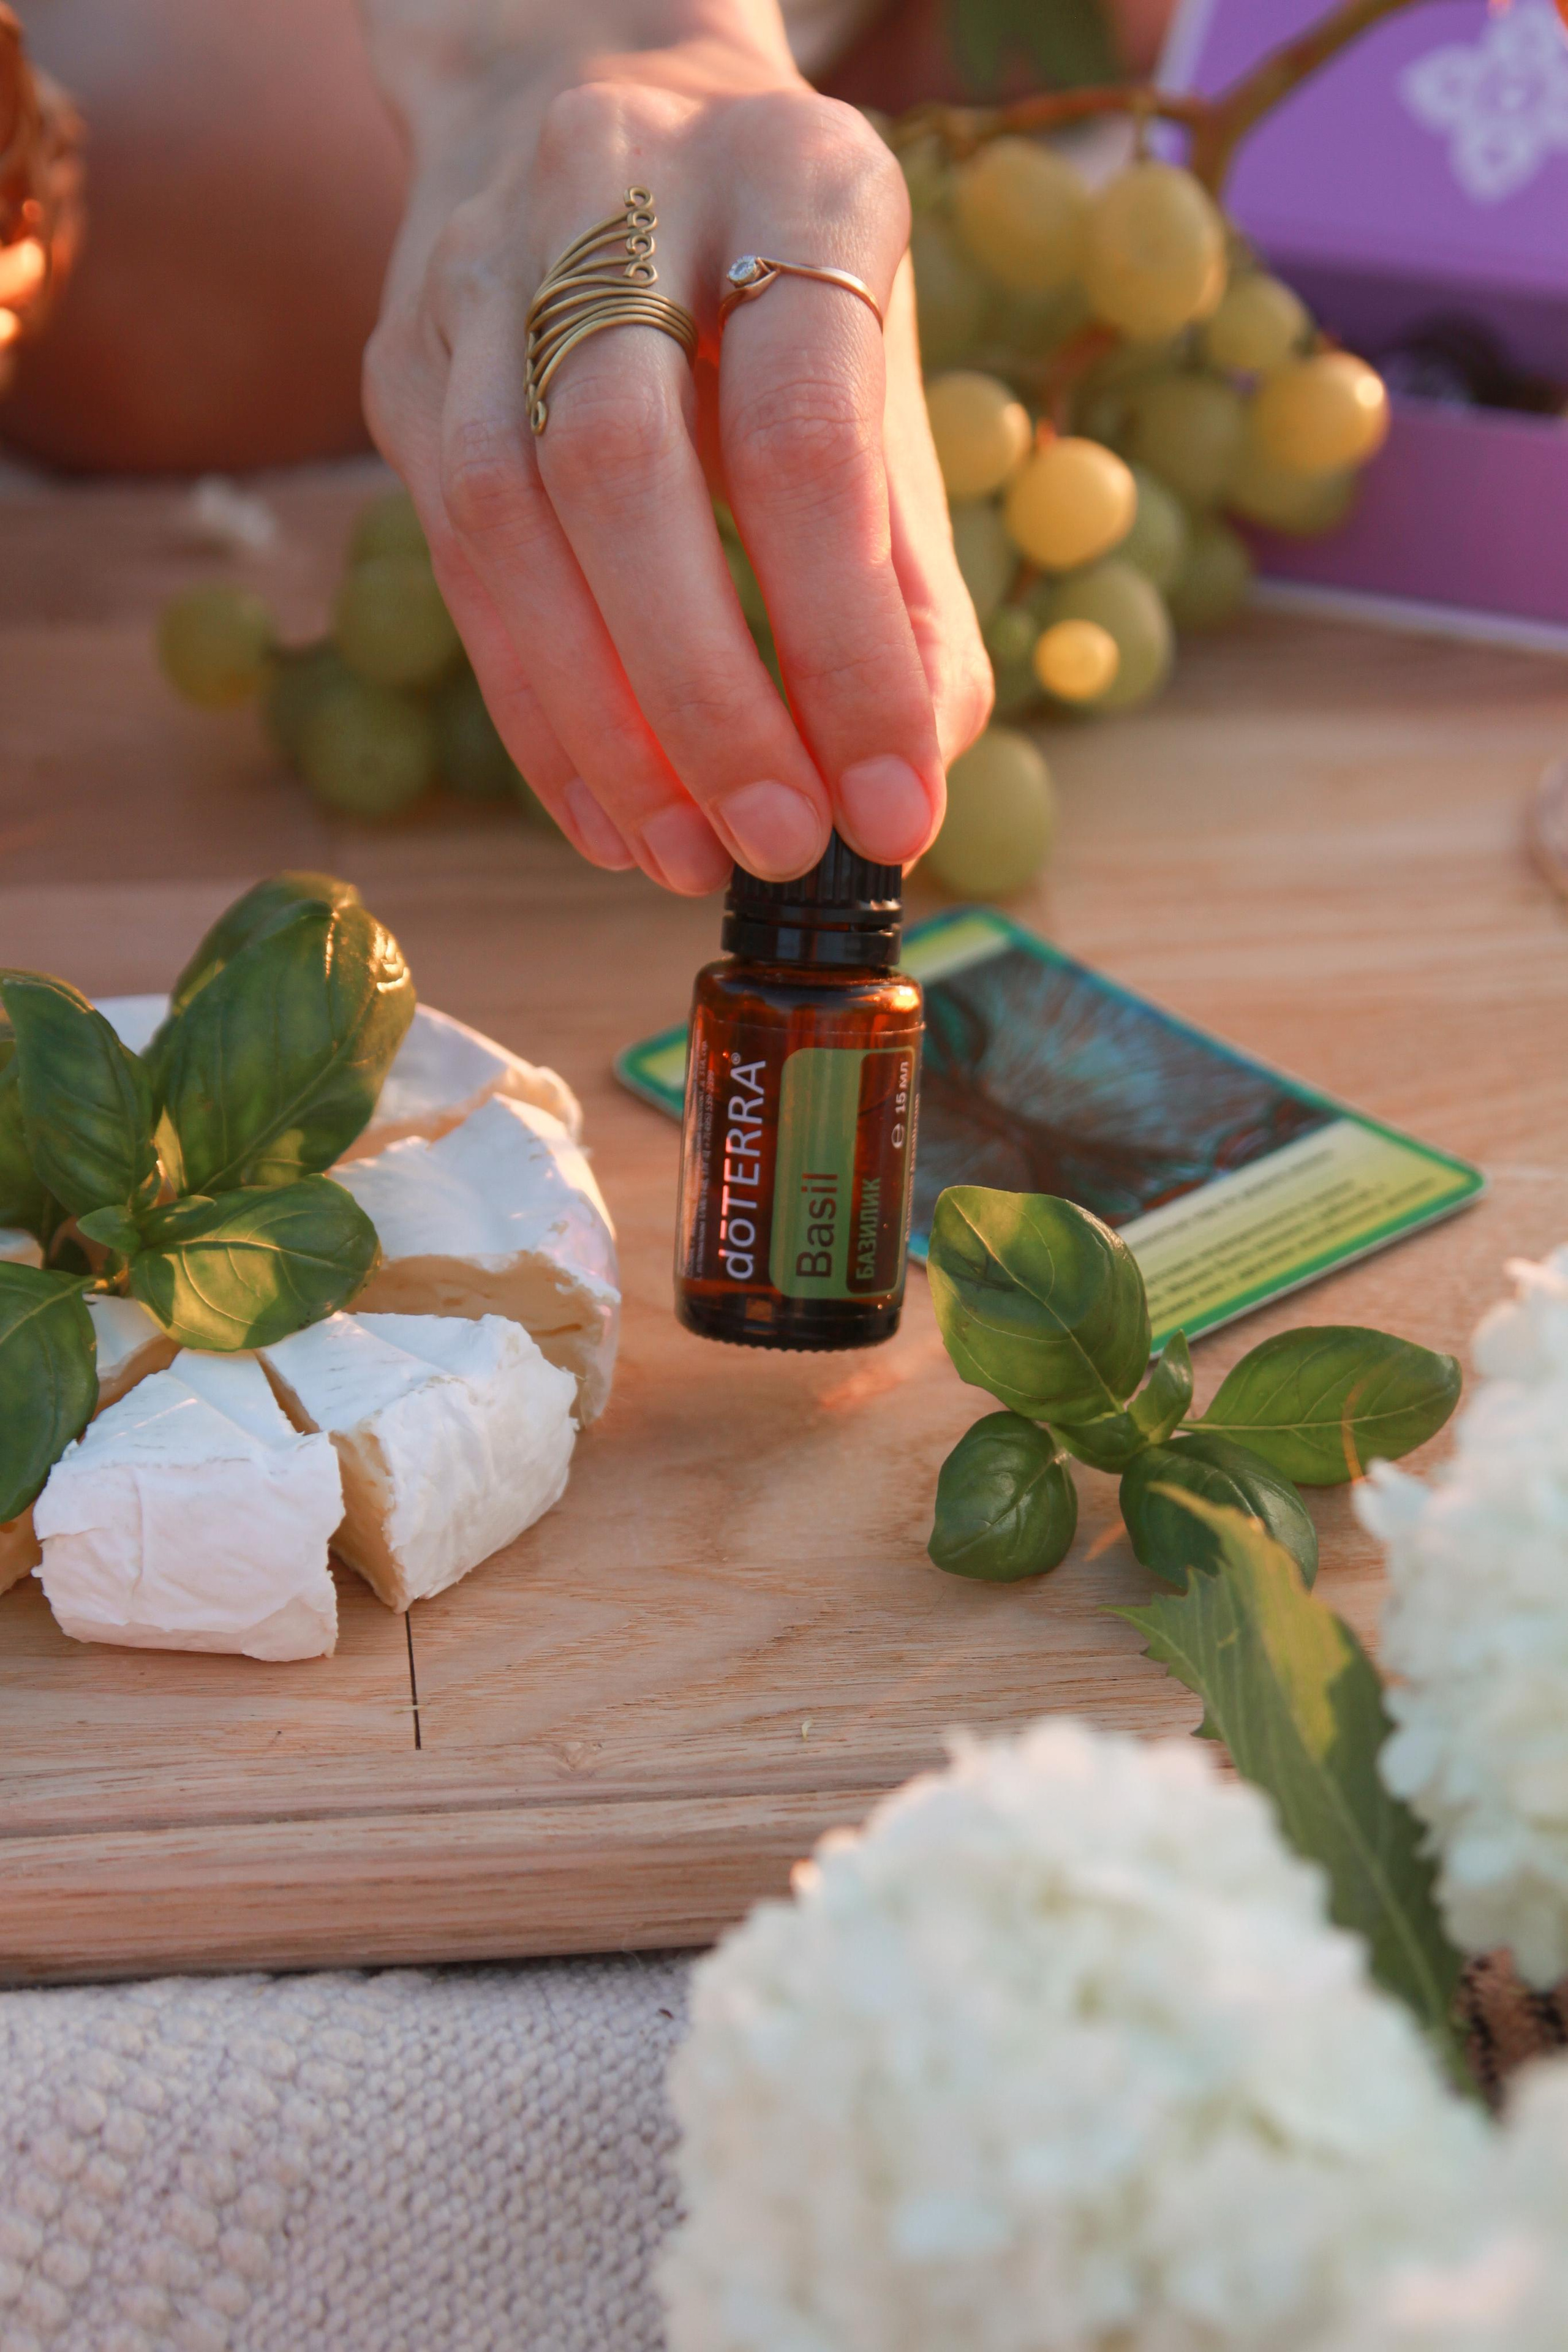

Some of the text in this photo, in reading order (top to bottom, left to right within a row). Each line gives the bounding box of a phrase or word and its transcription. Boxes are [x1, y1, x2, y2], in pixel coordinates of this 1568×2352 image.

[895, 1092, 907, 1114] 15
[899, 1061, 910, 1088] мл
[797, 1173, 838, 1278] Basil
[856, 1177, 880, 1280] БАЗИЛИК
